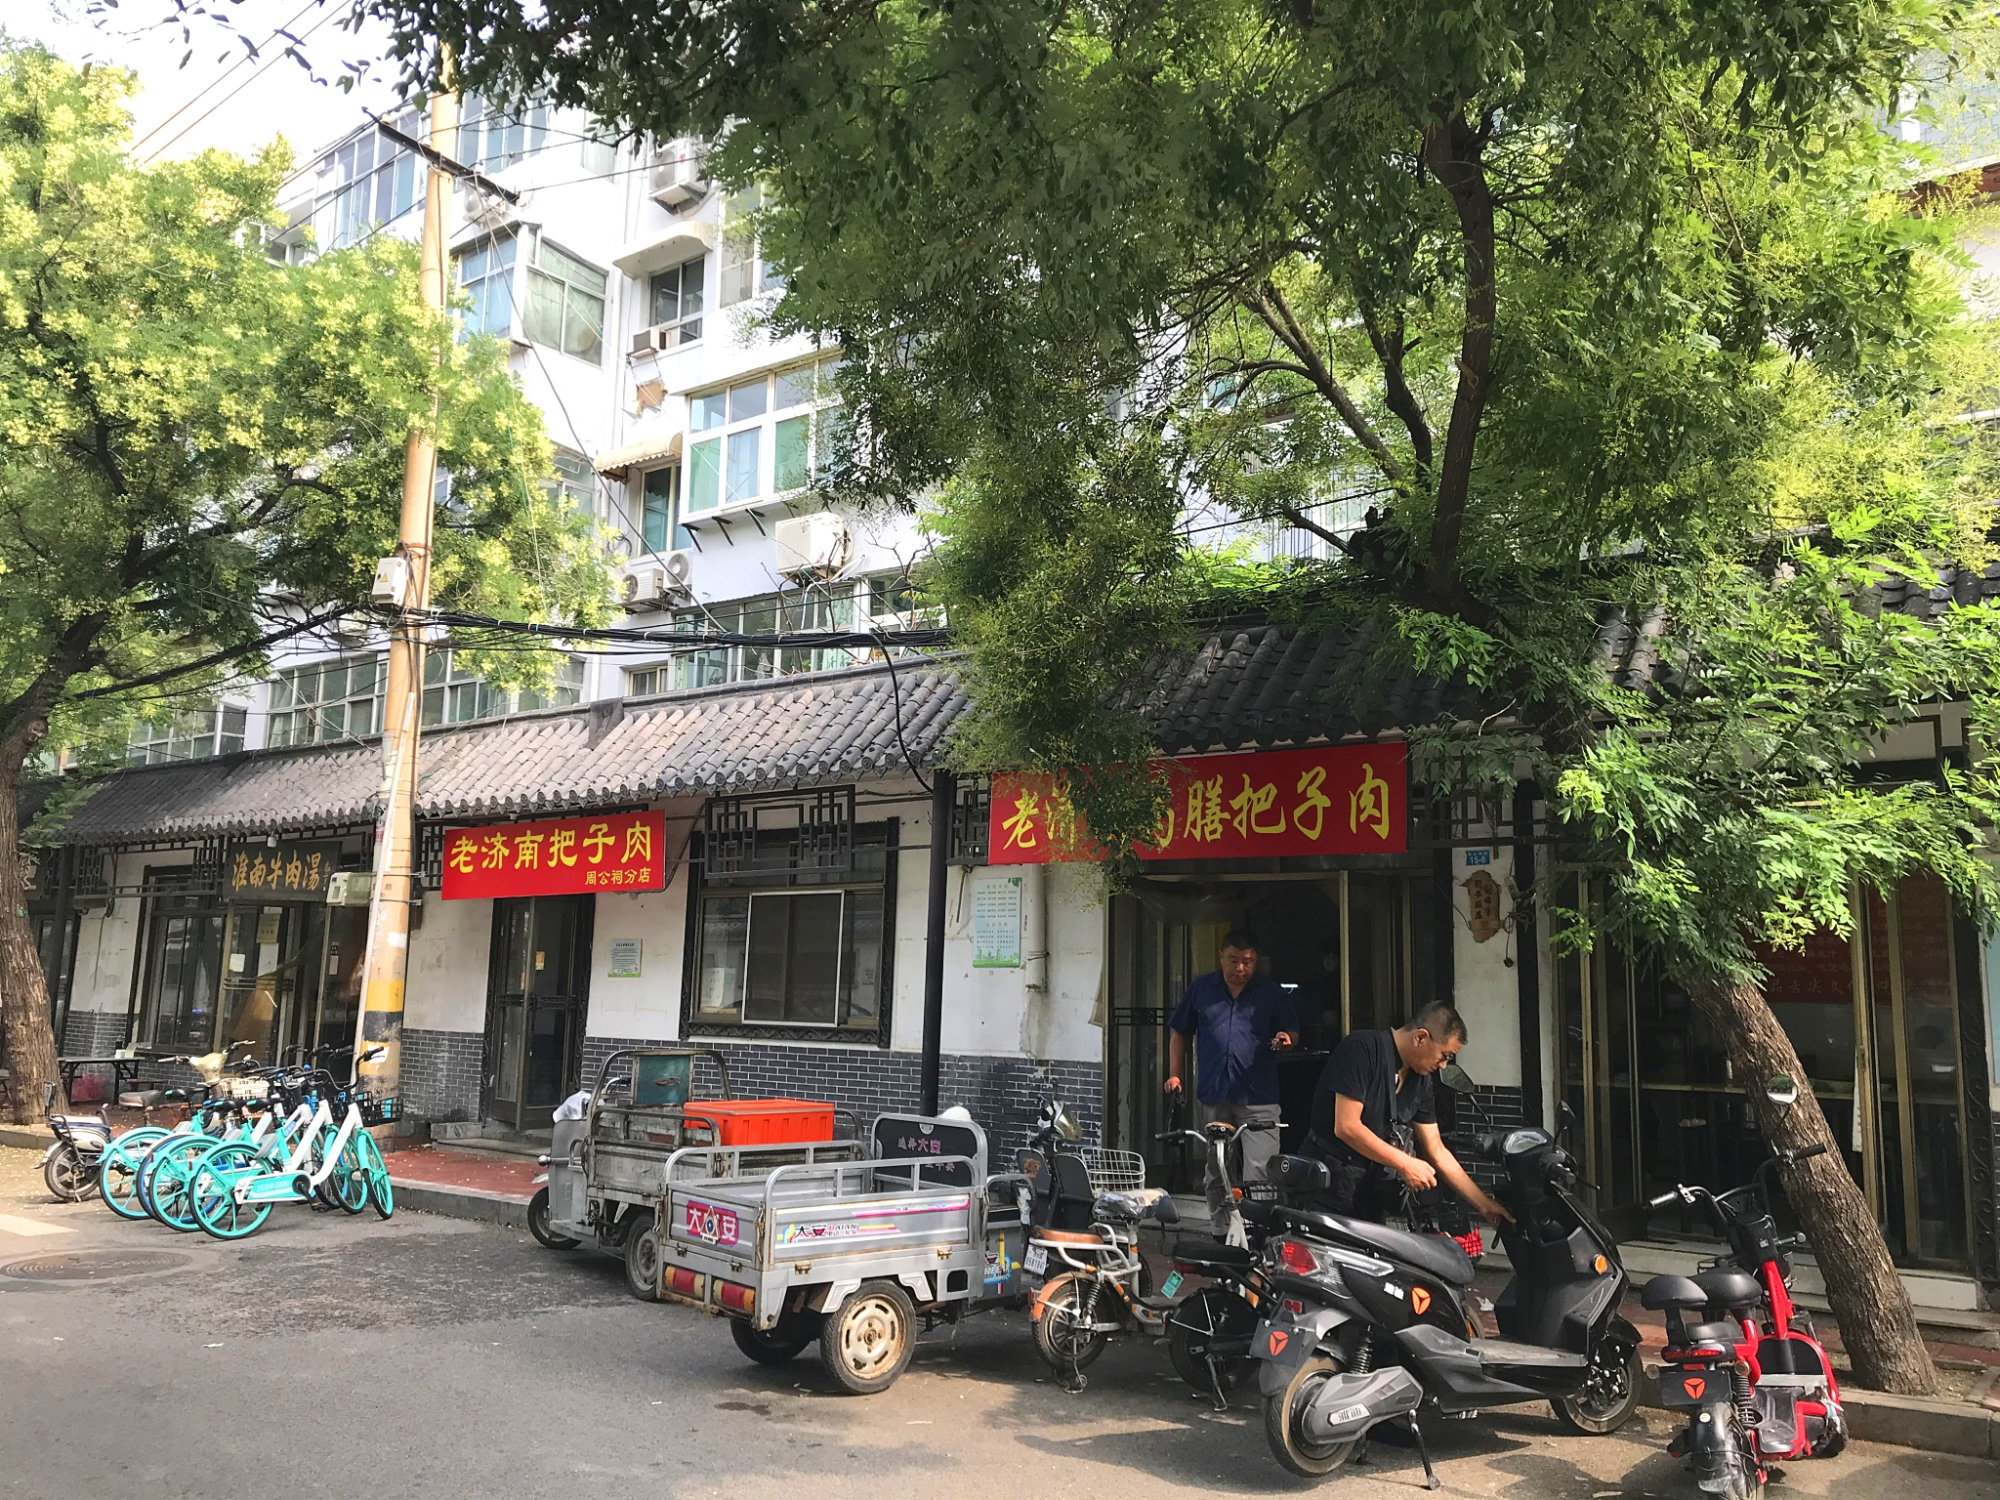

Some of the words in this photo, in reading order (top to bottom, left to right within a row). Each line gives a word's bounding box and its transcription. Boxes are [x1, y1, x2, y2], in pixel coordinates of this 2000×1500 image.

[1002, 763, 1390, 850] 老济膳把子肉
[450, 820, 652, 874] 老济南把子肉
[585, 867, 652, 886] 周公祠分店
